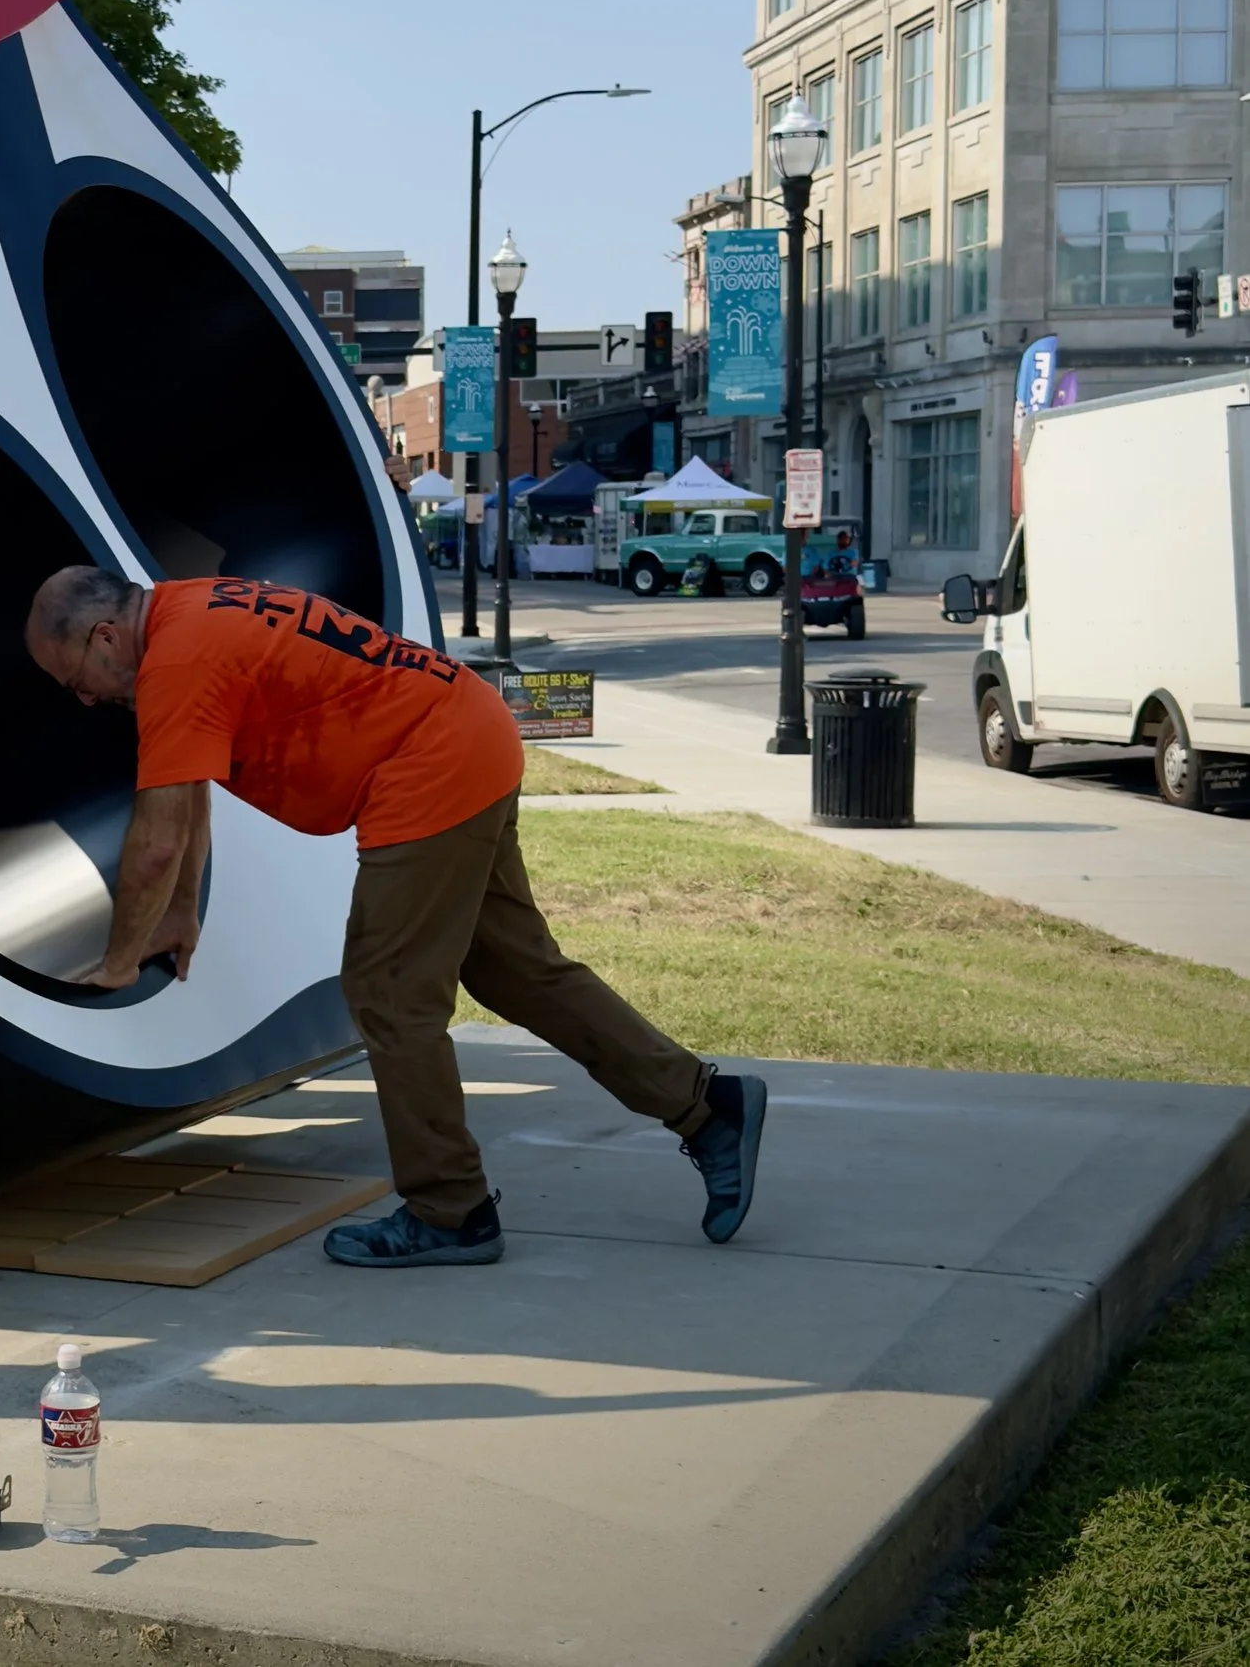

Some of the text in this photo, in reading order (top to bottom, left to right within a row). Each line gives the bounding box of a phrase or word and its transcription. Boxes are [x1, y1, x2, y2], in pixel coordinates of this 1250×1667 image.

[709, 253, 779, 274] DOWN
[710, 272, 780, 292] TOWN
[446, 355, 493, 369] TOWN
[503, 675, 522, 688] FREE
[523, 674, 549, 688] ROUTE
[550, 674, 561, 687] 66
